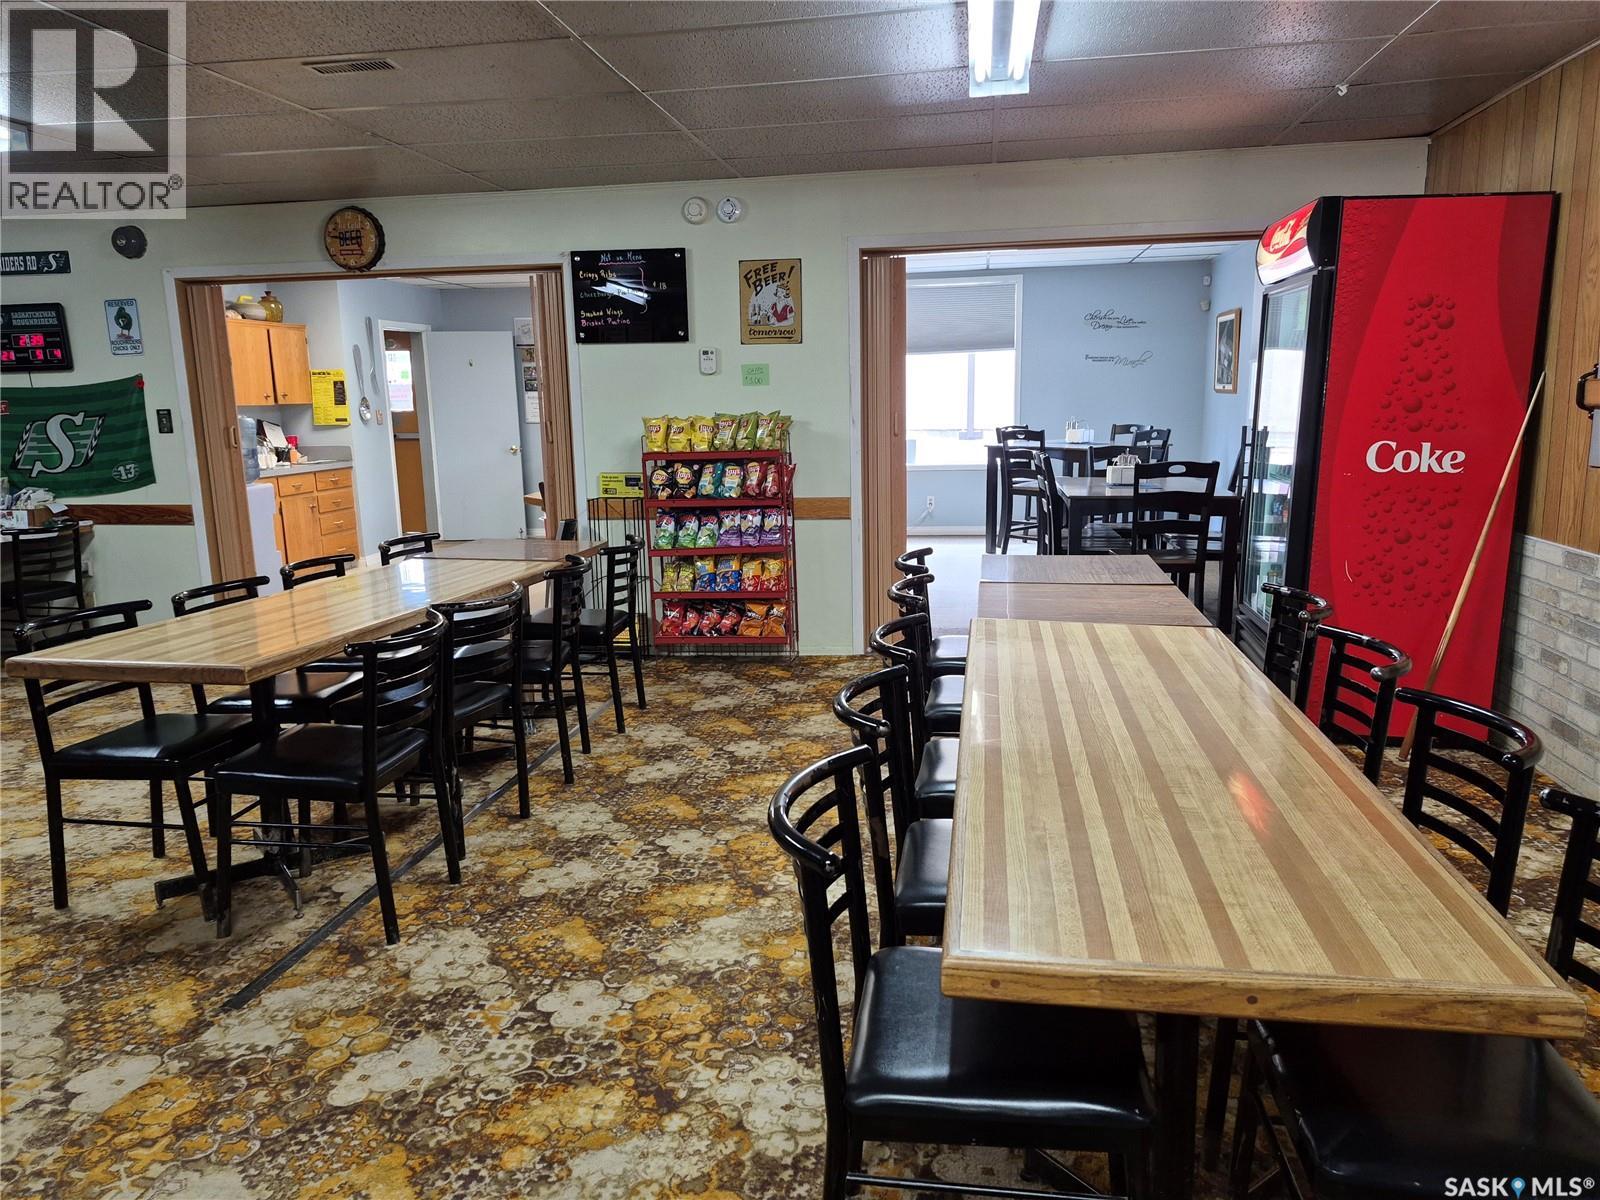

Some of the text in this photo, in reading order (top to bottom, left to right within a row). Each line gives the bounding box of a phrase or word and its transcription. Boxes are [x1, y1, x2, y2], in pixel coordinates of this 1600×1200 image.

[338, 230, 363, 247] BEER
[26, 255, 37, 271] RD
[743, 262, 778, 289] FREE
[108, 300, 135, 308] RESERVED
[11, 311, 57, 319] SASKATCHEWAN
[13, 318, 58, 326] ROUGHRIDERS
[748, 327, 797, 337] tomorrow
[1365, 440, 1466, 474] Coke
[117, 463, 136, 480] 13
